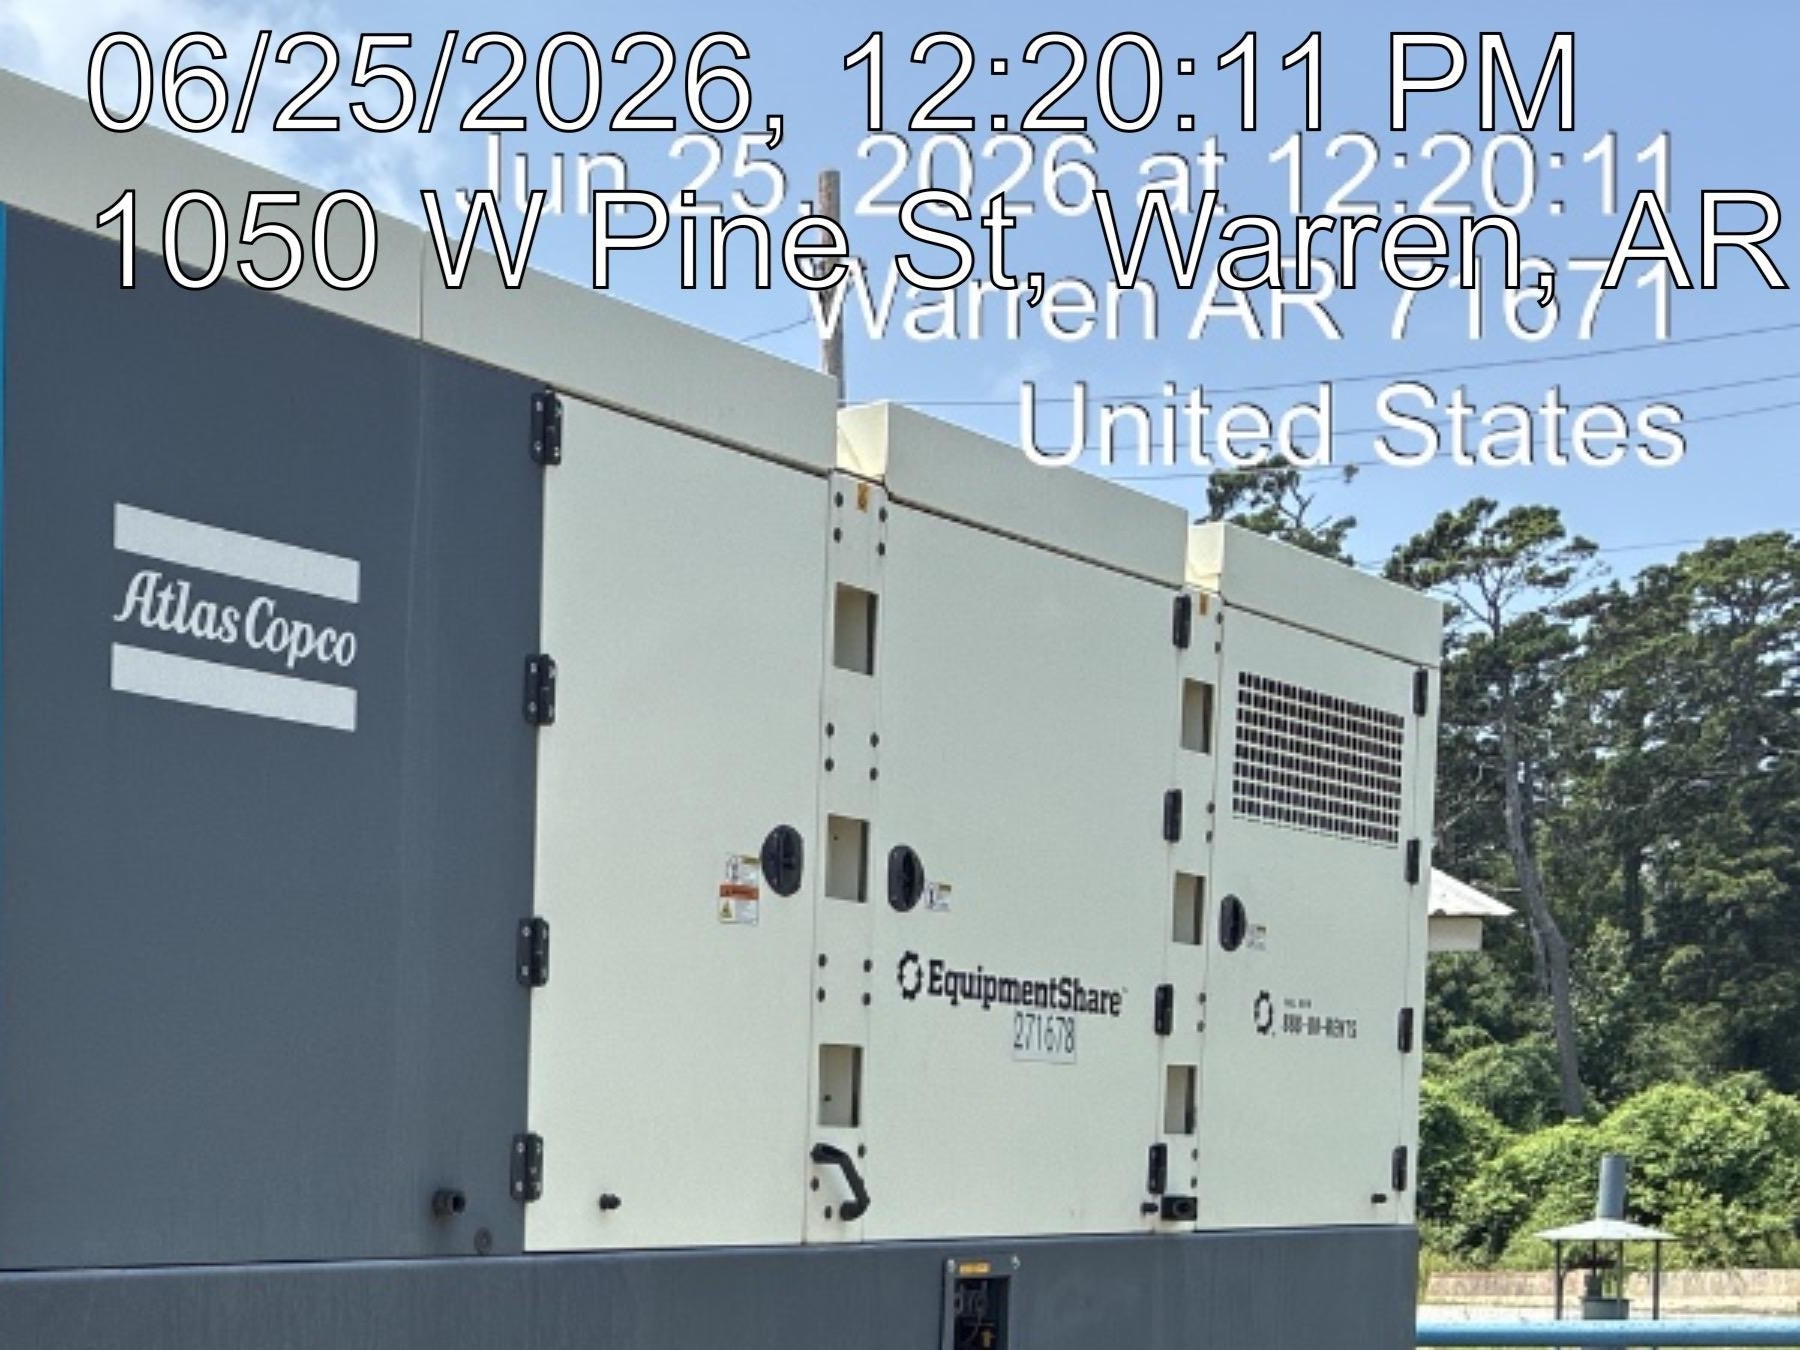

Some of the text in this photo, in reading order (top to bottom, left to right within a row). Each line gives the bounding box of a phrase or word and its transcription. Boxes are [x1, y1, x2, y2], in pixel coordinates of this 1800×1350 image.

[113, 569, 358, 669] Atlas Copco
[927, 959, 1124, 1017] EquipmentShare
[1013, 1011, 1076, 1054] 271678
